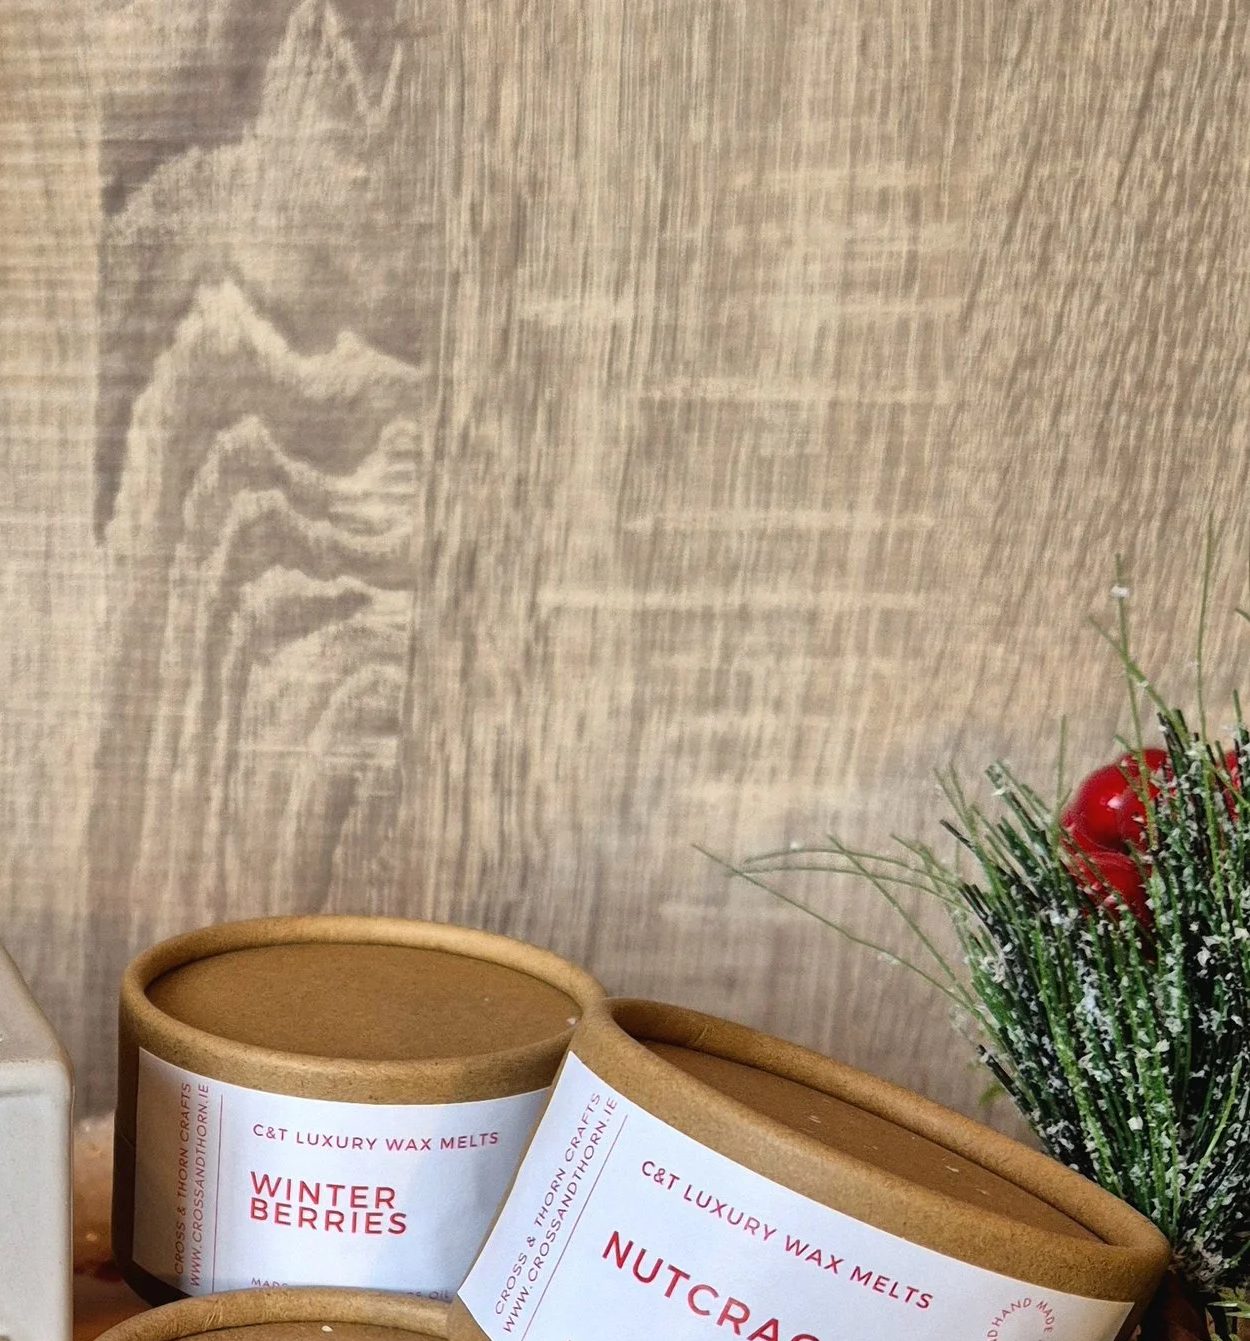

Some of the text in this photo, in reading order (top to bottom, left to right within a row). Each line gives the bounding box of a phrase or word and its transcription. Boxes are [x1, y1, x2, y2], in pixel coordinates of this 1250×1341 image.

[174, 1082, 191, 1275] CROSS & THORN CRAFTS
[190, 1083, 209, 1286] WWW.CROSSANDTHORN.IE
[250, 1171, 397, 1209] WINTER
[253, 1123, 499, 1151] C&T LUXURY WAX MELTS
[495, 1092, 601, 1315] CROSS & THORN CRAFTS
[250, 1196, 407, 1235] BERRIES
[503, 1097, 618, 1333] WWW.CROSSANDTHORN.IE
[641, 1160, 934, 1310] C&T LUXURY WAX MELTS
[991, 1297, 1032, 1327] HAND
[1036, 1300, 1055, 1334] MADE
